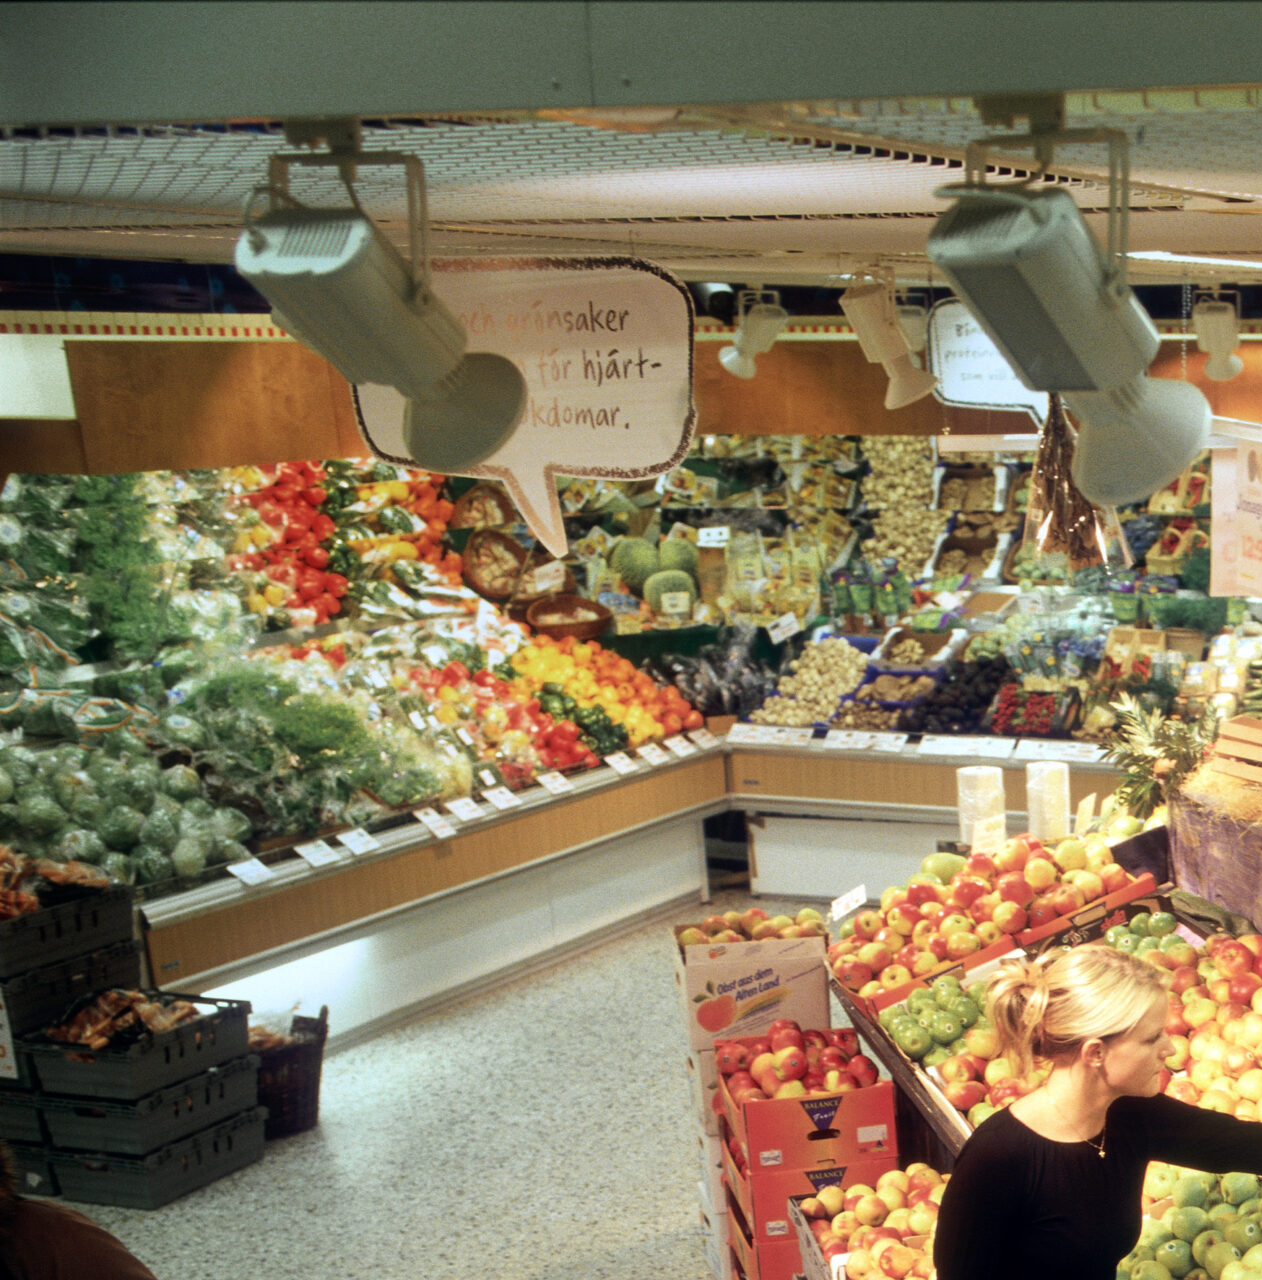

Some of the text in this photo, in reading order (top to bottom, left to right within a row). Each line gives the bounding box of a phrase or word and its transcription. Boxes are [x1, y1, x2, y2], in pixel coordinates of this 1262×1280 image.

[758, 975, 779, 992] Land
[804, 1100, 840, 1109] BALANCE
[809, 1170, 844, 1179] BALANCE
